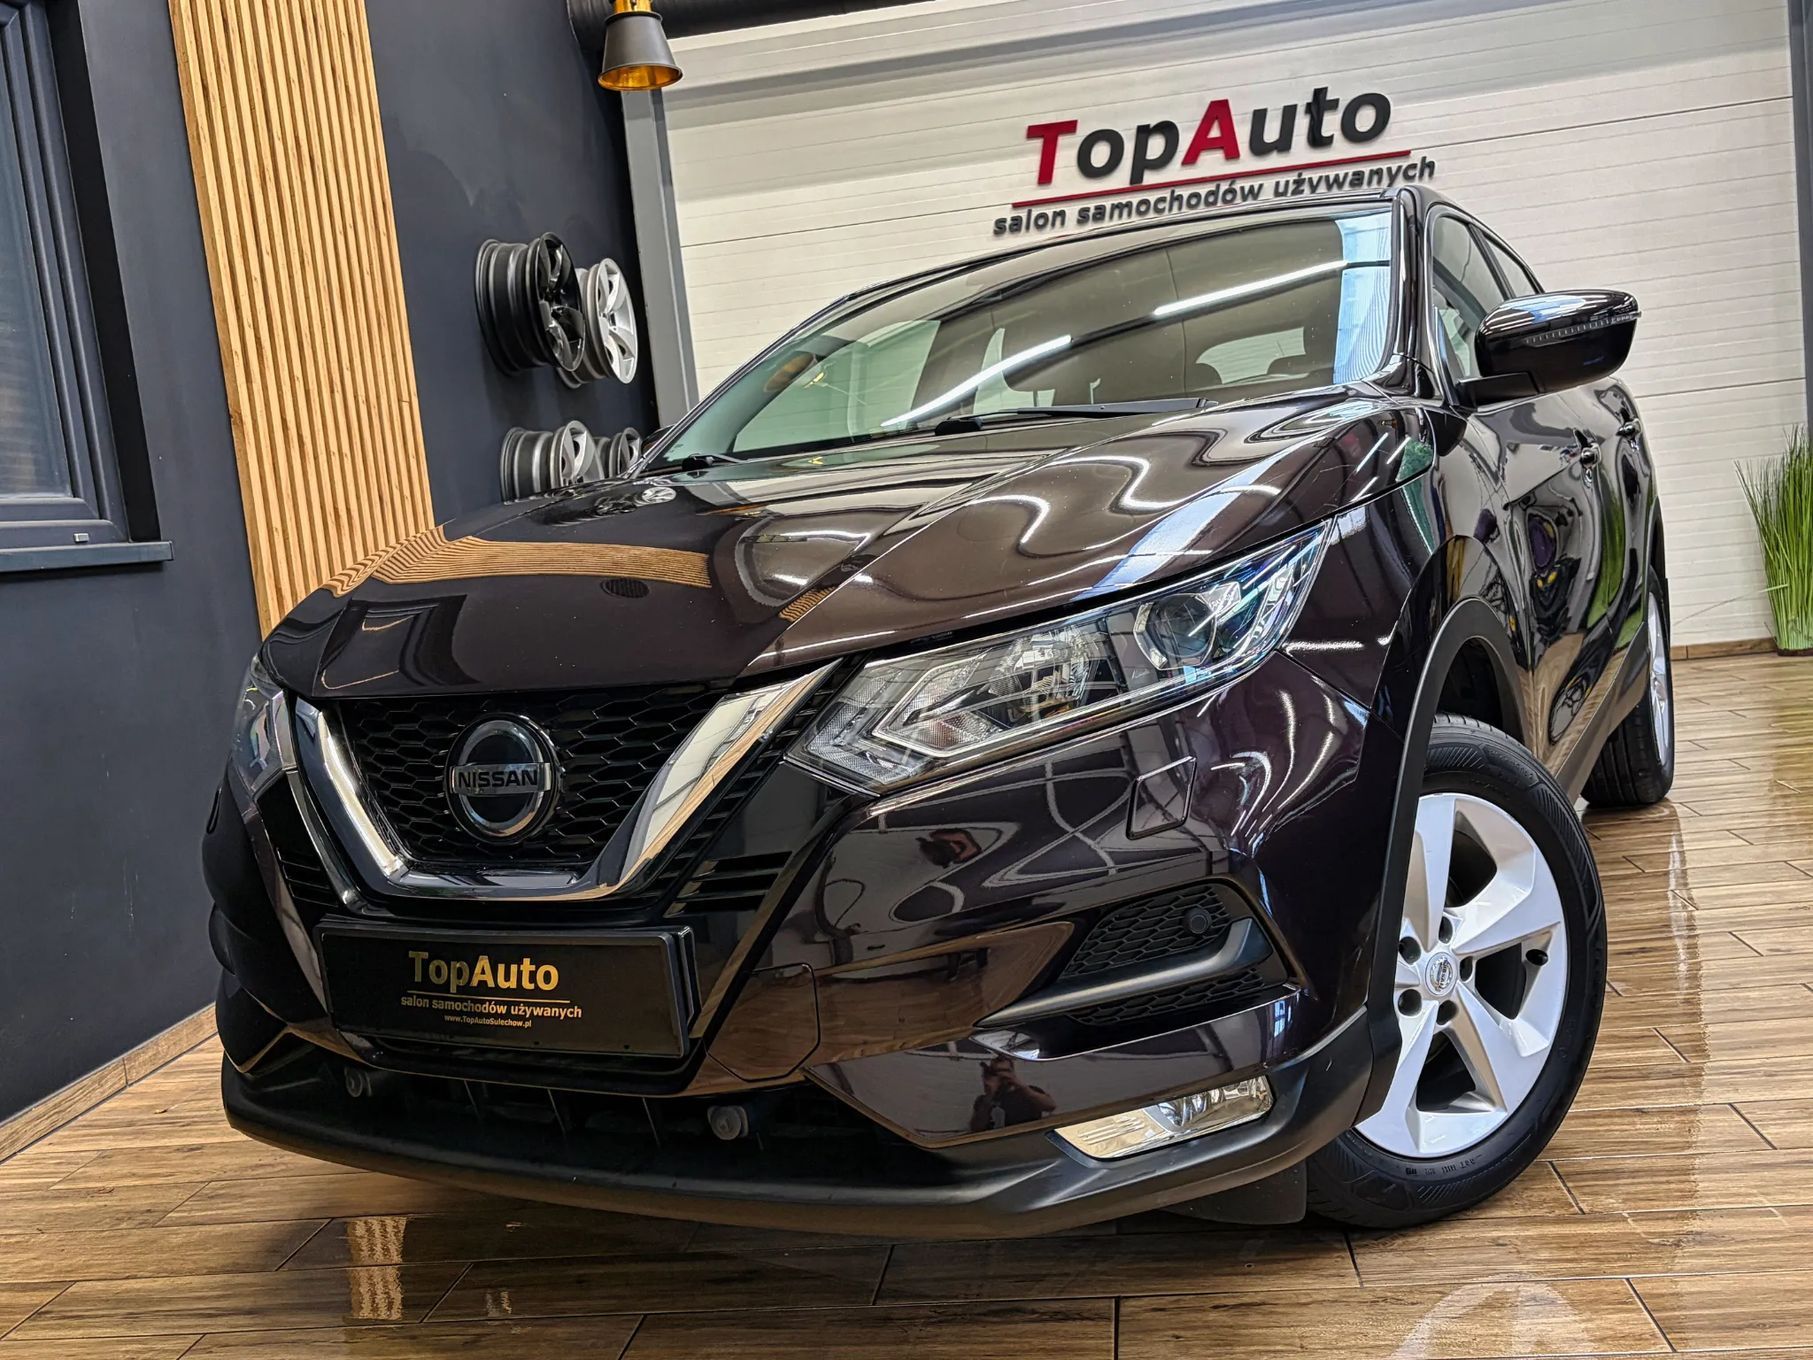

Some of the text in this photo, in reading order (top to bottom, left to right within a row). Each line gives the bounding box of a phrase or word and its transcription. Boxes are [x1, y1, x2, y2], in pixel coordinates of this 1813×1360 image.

[1025, 86, 1392, 186] TopAuto
[993, 155, 1436, 236] salon samochodów używanych
[458, 769, 538, 788] NISSAN
[408, 950, 560, 993] TopAuto
[401, 994, 583, 1020] salon samochodów używanych
[444, 1014, 532, 1028] www.TopAutoSulechow.pl
